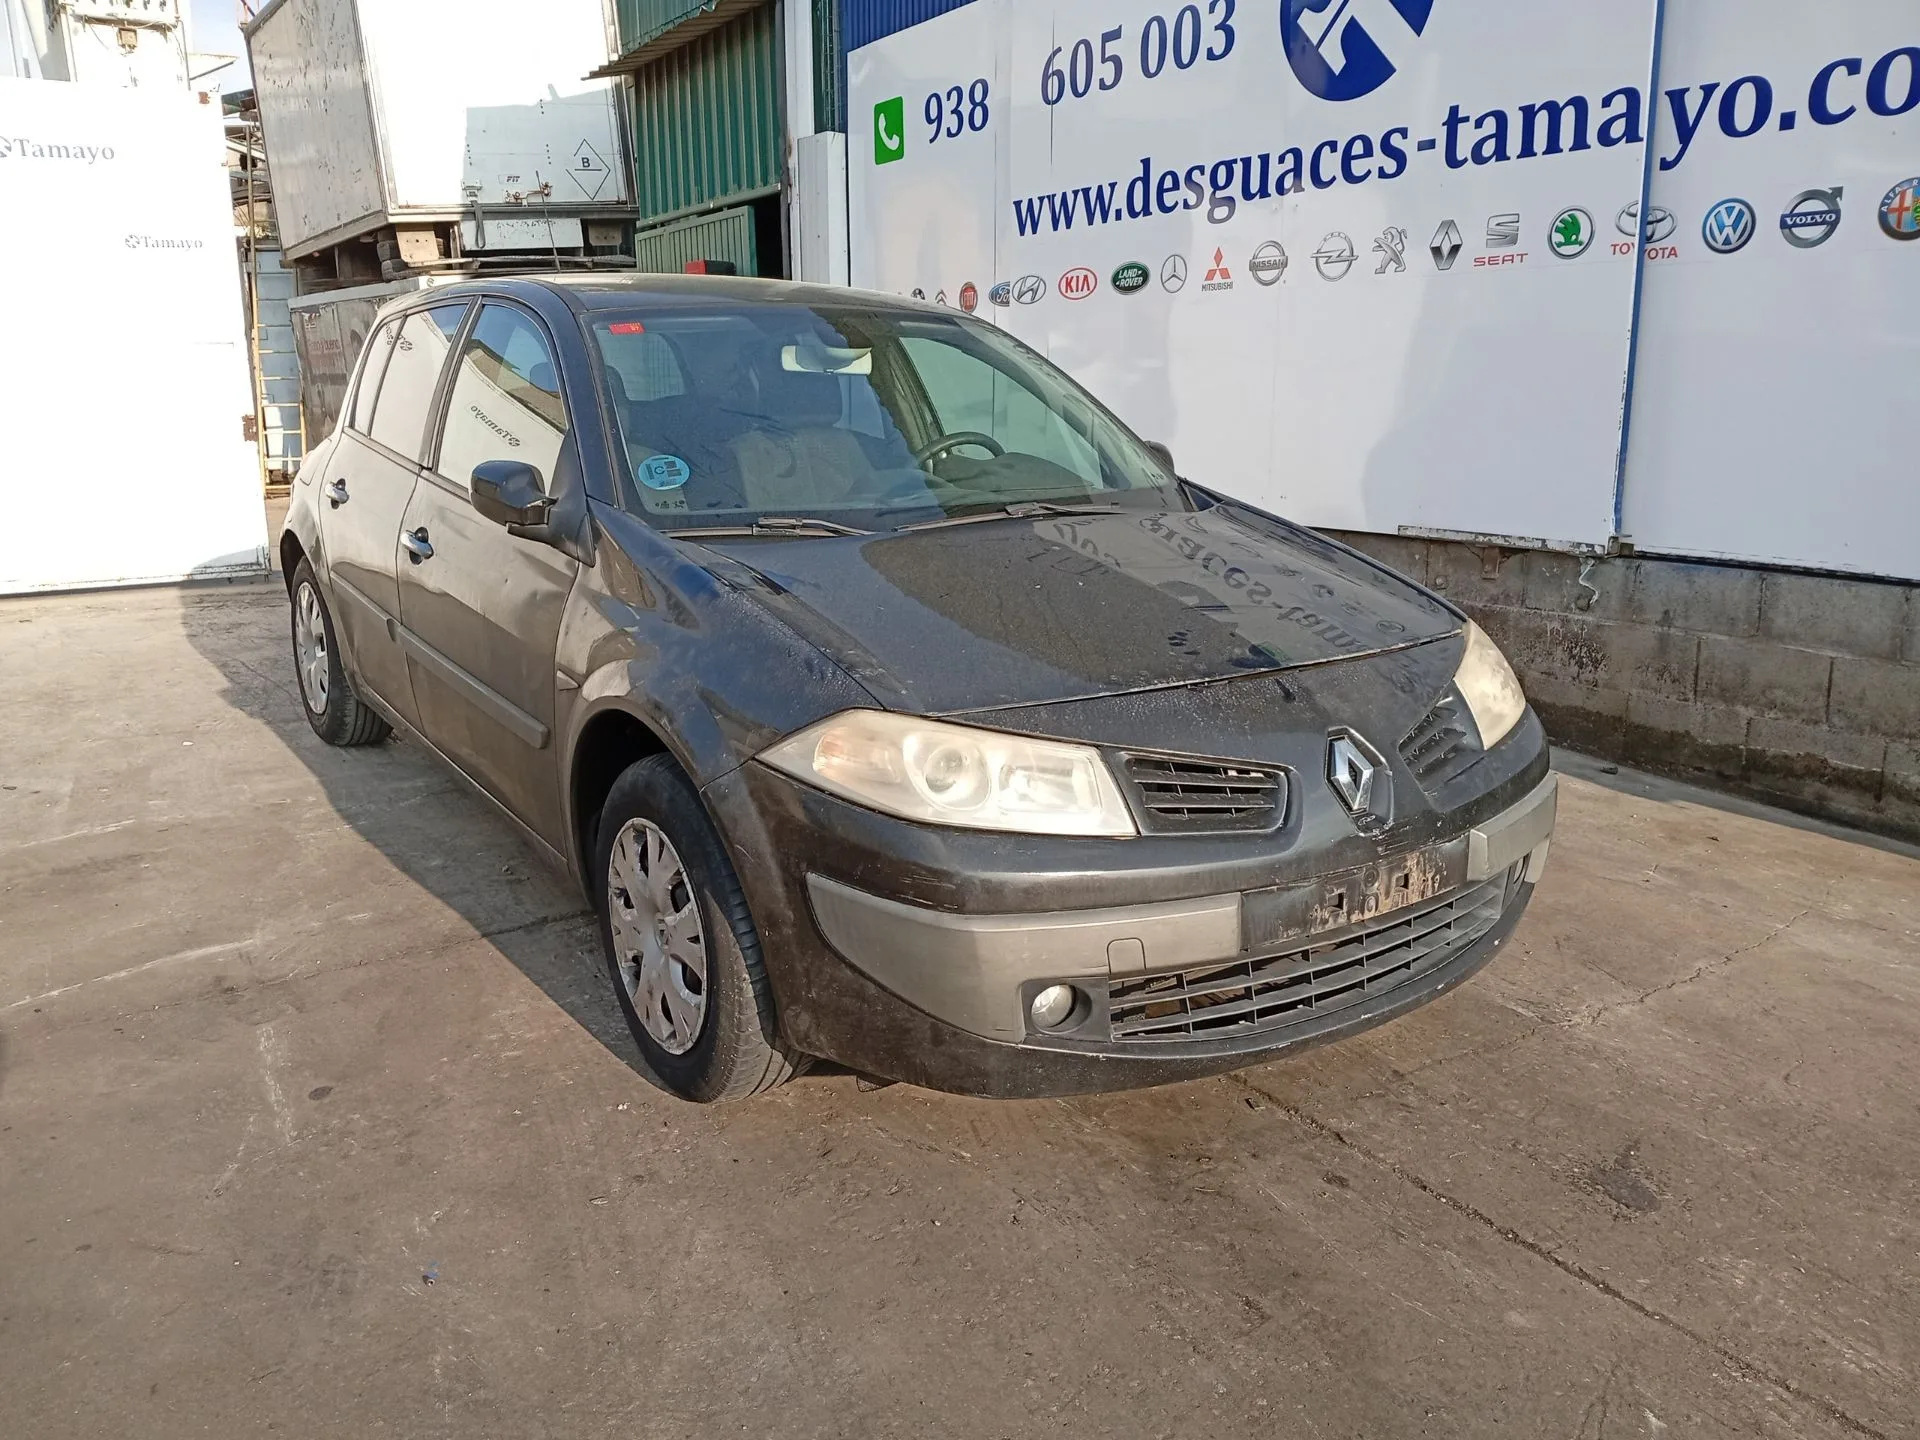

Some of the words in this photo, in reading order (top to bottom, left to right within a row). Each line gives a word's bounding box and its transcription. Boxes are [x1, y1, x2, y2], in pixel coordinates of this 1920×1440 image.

[924, 78, 990, 143] 938
[1041, 24, 1123, 106] 605
[1140, 0, 1236, 79] 003
[13, 138, 115, 165] Tamayo
[581, 157, 591, 168] B
[1784, 212, 1836, 226] VOLVO
[141, 235, 204, 252] Tamayo
[1252, 258, 1285, 269] NISSAN
[1473, 252, 1529, 267] SEAT
[1118, 268, 1138, 279] LAND
[1065, 274, 1091, 294] KIA
[1119, 276, 1143, 288] ROVER
[1201, 281, 1233, 292] MITSUBISHI
